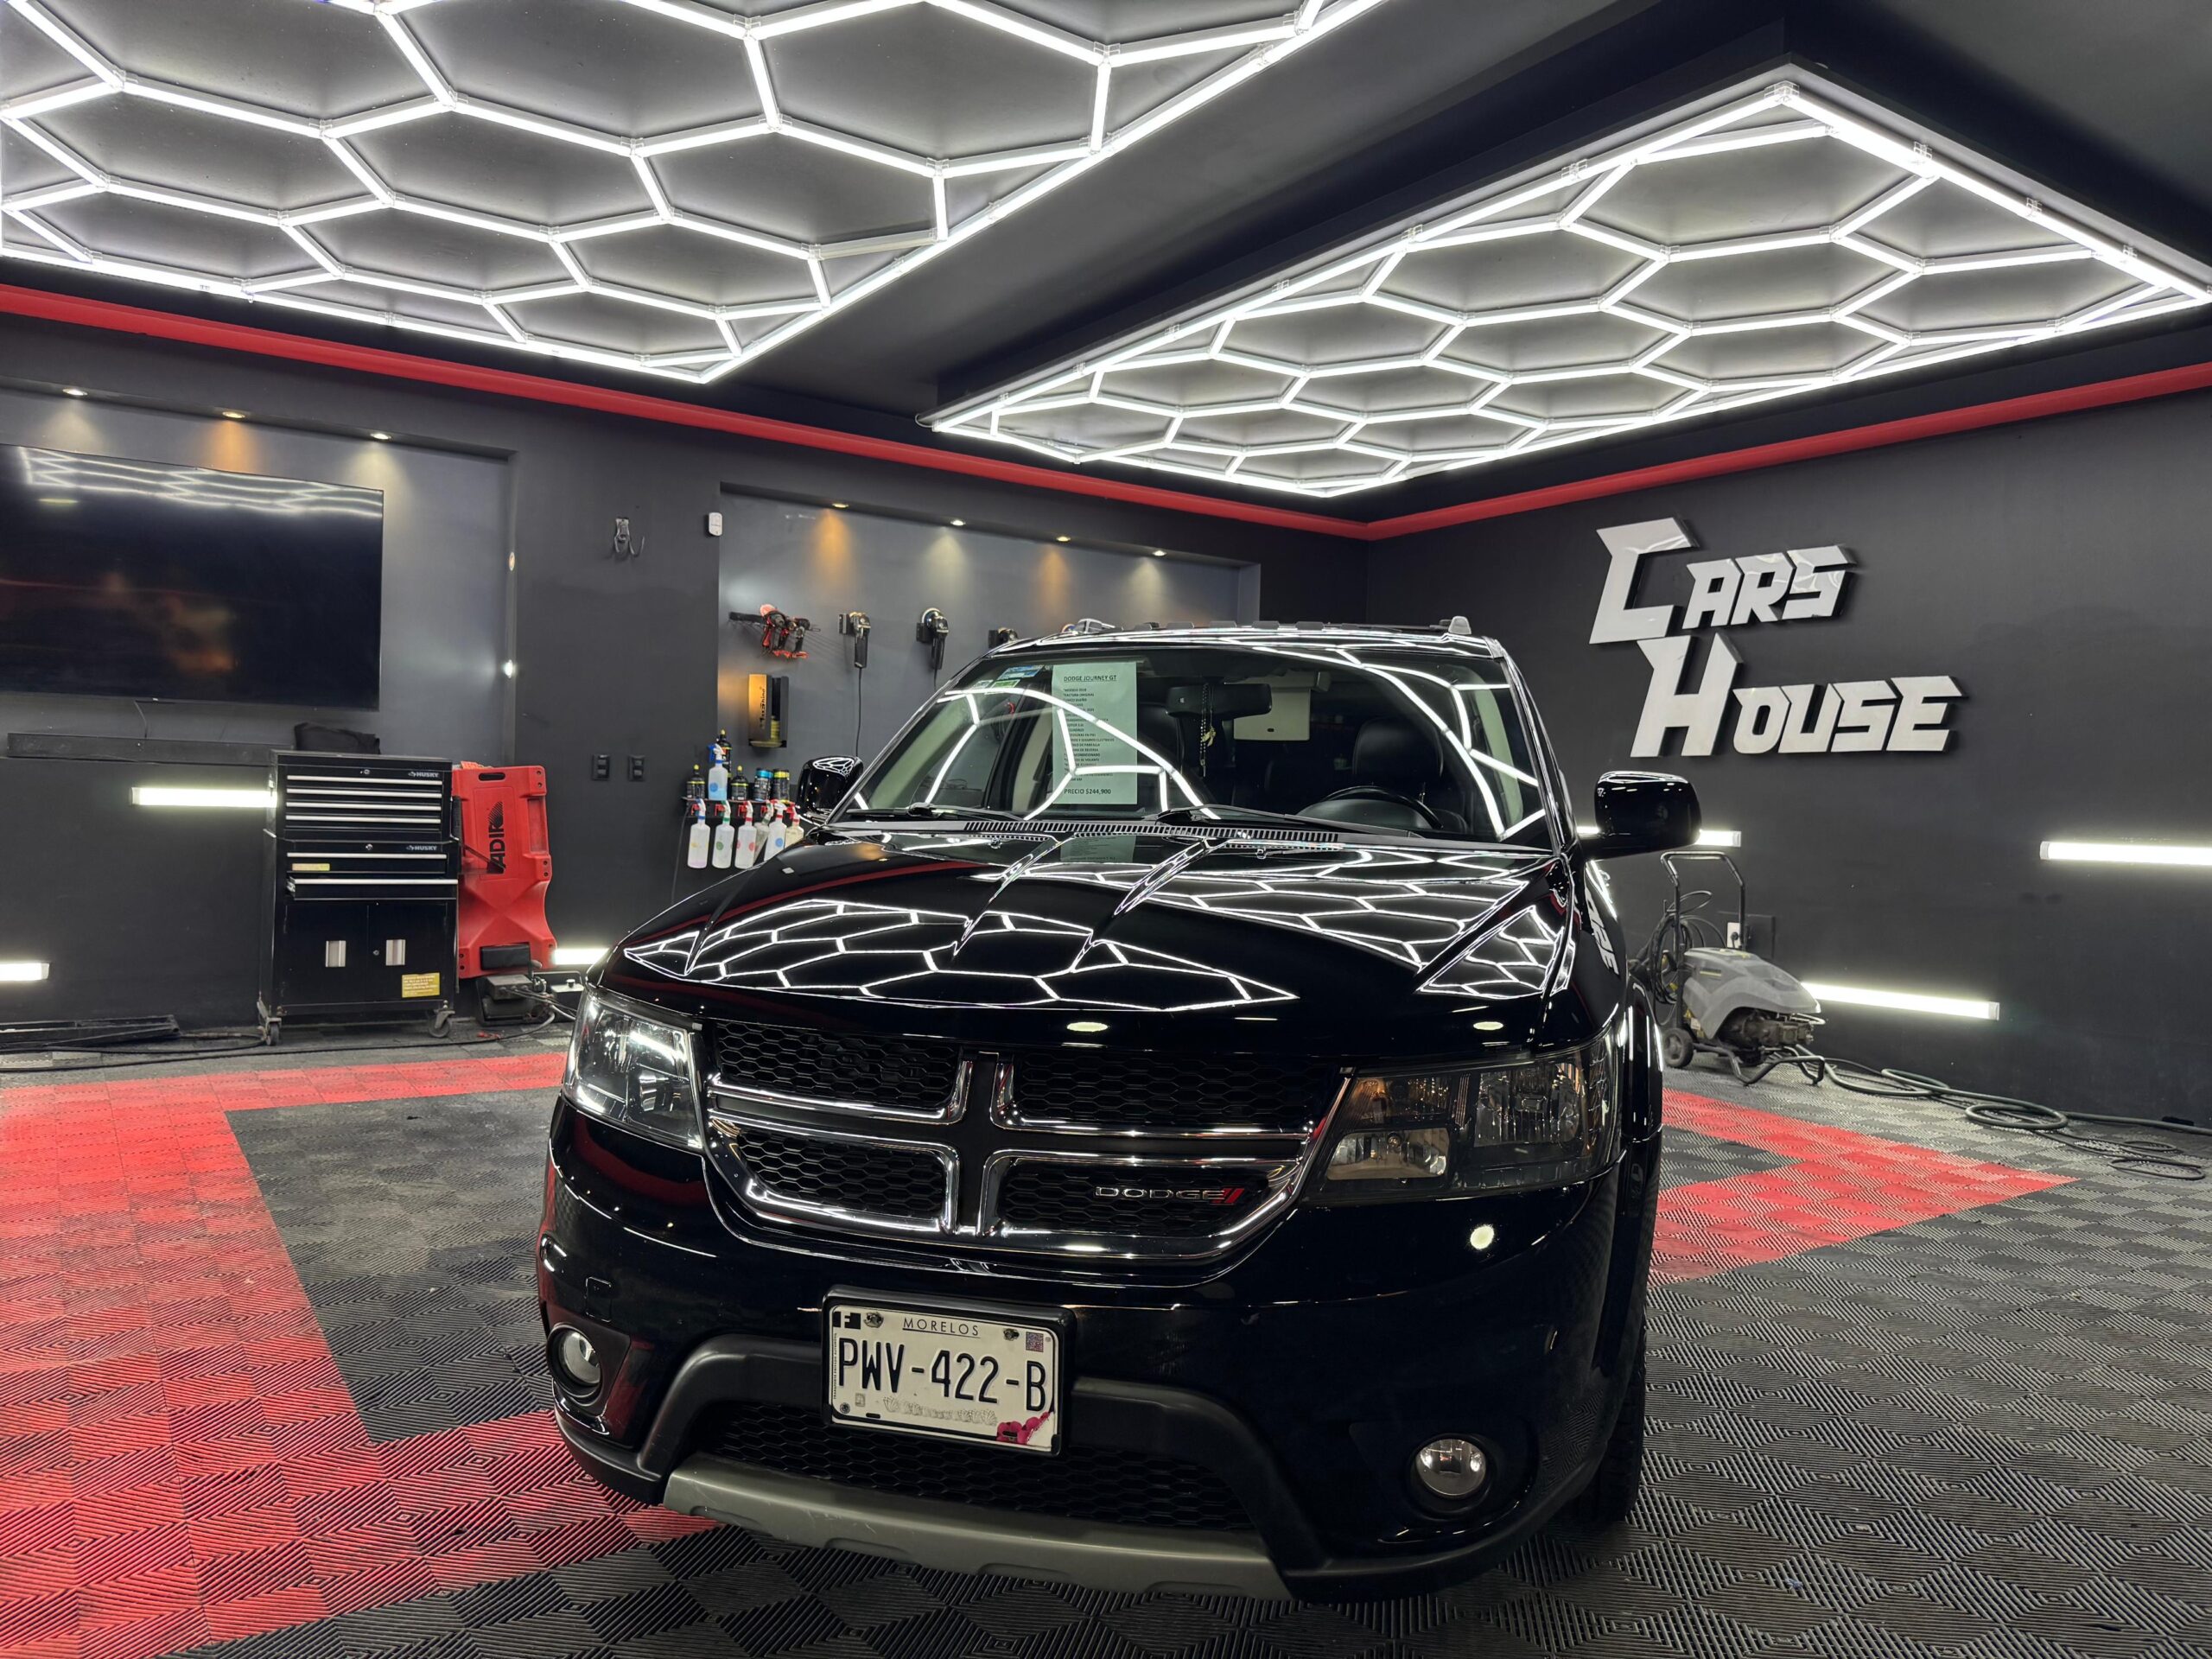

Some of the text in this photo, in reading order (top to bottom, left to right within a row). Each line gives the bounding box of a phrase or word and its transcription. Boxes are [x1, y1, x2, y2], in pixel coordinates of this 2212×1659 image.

[1096, 1186, 1225, 1200] DODGE
[903, 1317, 980, 1337] MORELOS
[838, 1338, 1046, 1412] PWV-422-B
